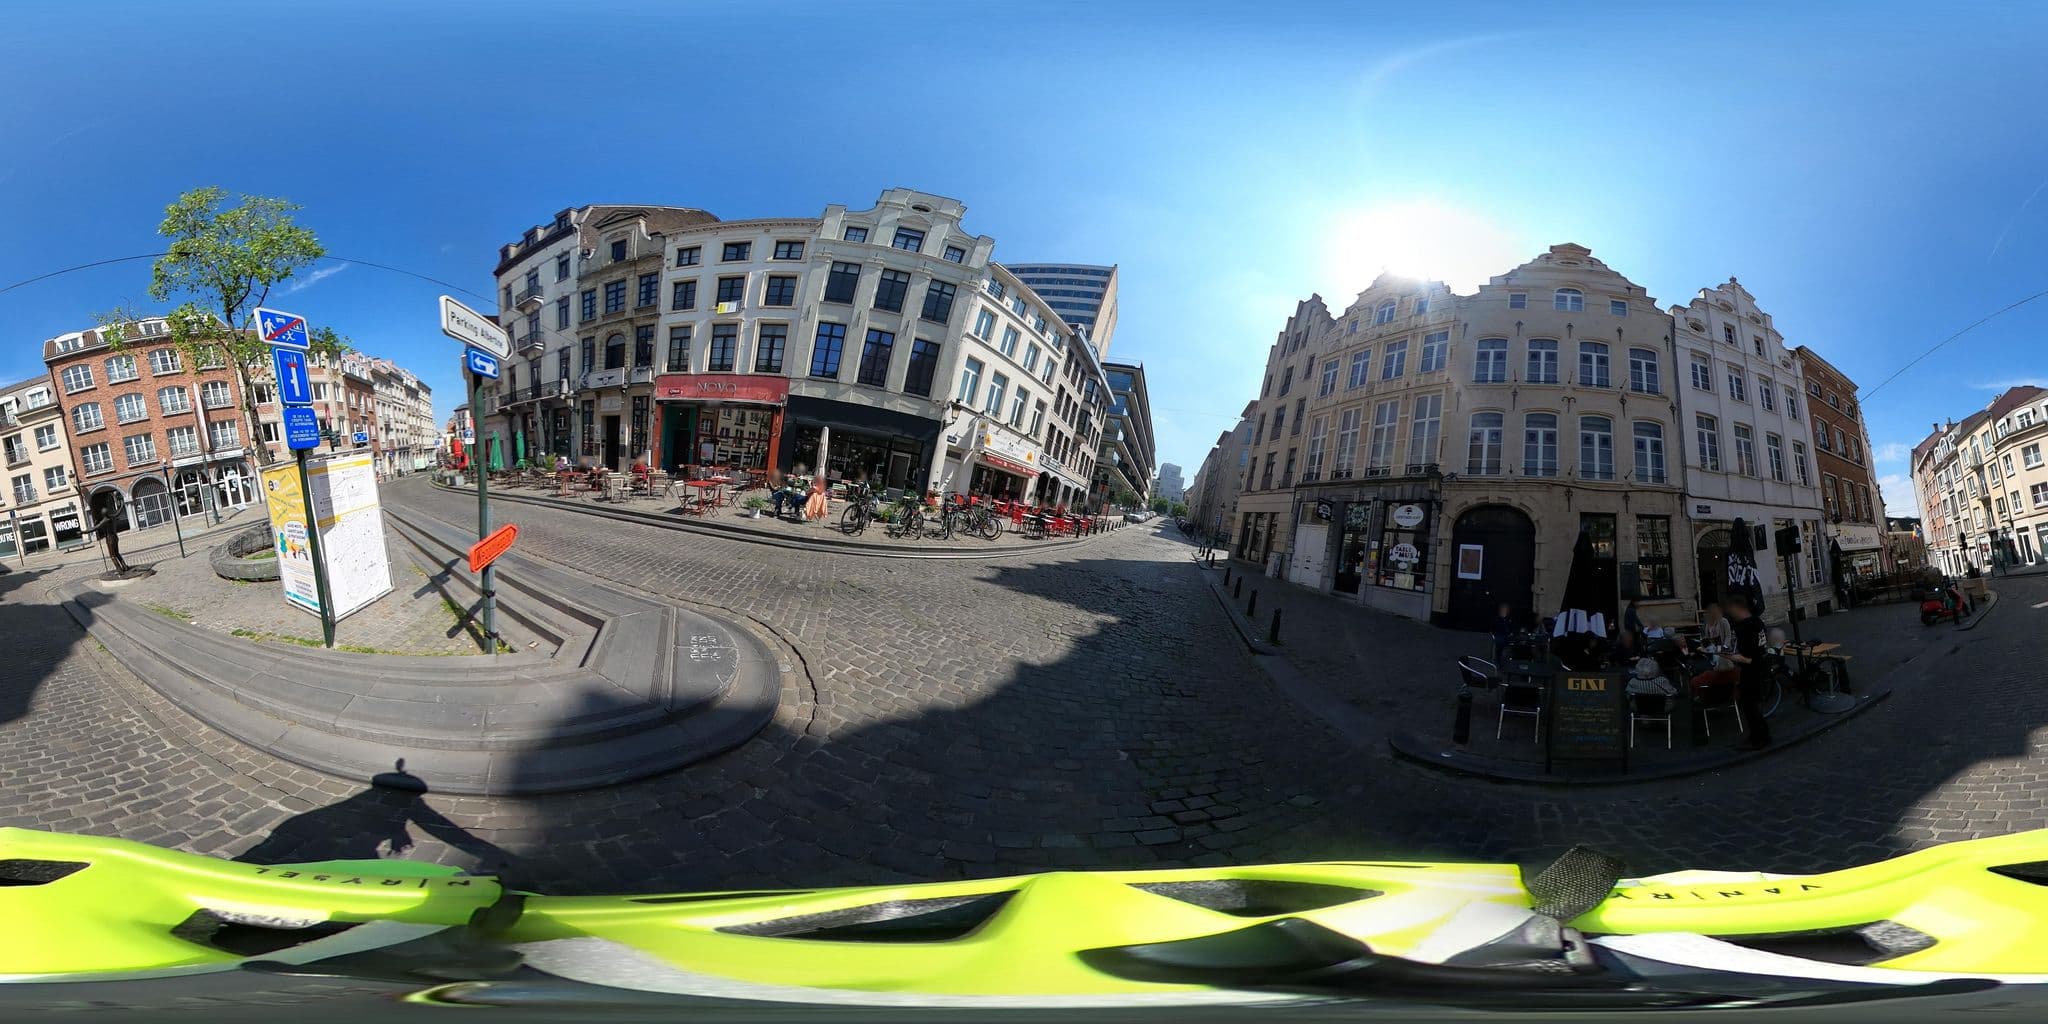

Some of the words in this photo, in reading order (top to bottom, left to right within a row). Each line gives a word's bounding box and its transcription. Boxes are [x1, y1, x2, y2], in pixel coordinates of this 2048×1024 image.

[450, 311, 478, 337] Parking
[697, 382, 737, 393] NOVO
[54, 518, 79, 532] WRONG
